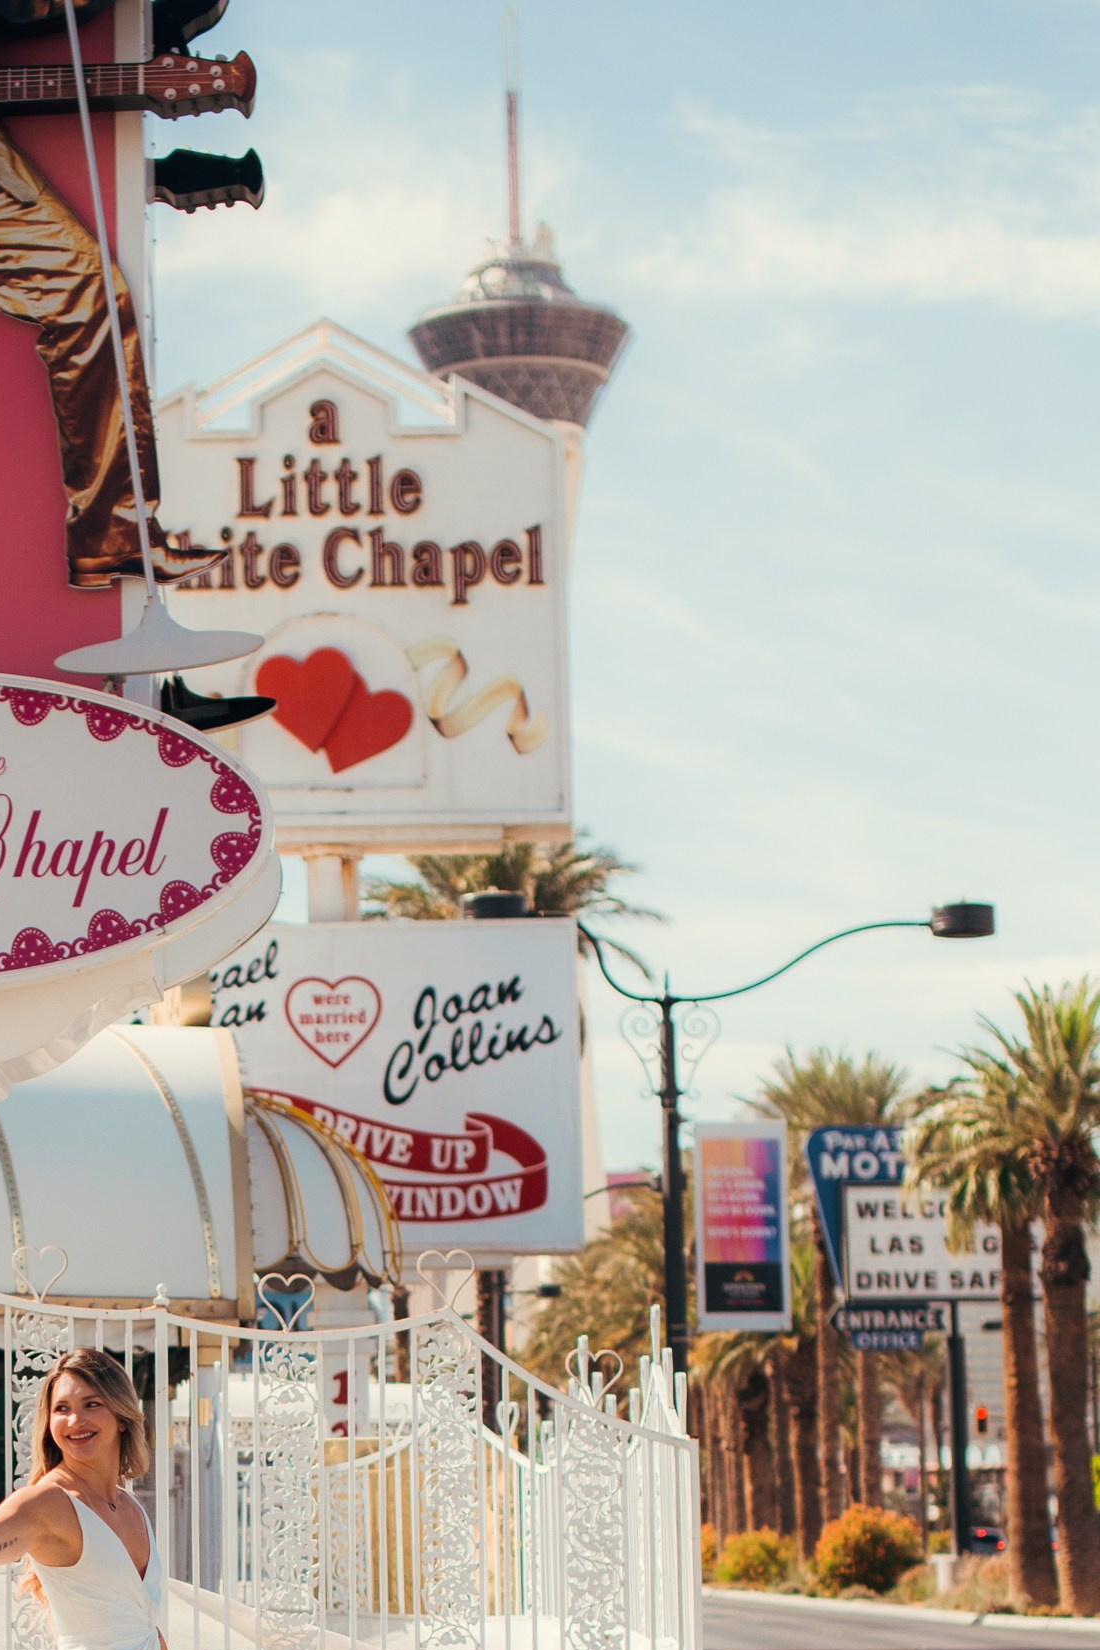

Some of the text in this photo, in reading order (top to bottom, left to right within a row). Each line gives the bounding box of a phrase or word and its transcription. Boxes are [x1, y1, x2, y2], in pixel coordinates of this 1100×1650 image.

[309, 399, 341, 444] a
[235, 454, 423, 517] Little
[170, 524, 545, 605] hite Chapel
[211, 939, 279, 994] ael
[312, 992, 351, 1005] were
[300, 1008, 366, 1024] married
[413, 973, 526, 1055] Joan
[314, 1029, 351, 1044] here
[384, 1014, 564, 1105] Collins
[313, 1106, 477, 1170] DRIVE UP
[820, 1151, 905, 1179] MOT
[870, 1236, 925, 1254] LAS
[856, 1270, 1002, 1289] DRIVE SAF
[836, 1309, 939, 1331] ENTRANCE
[857, 1332, 919, 1349] OFFICE
